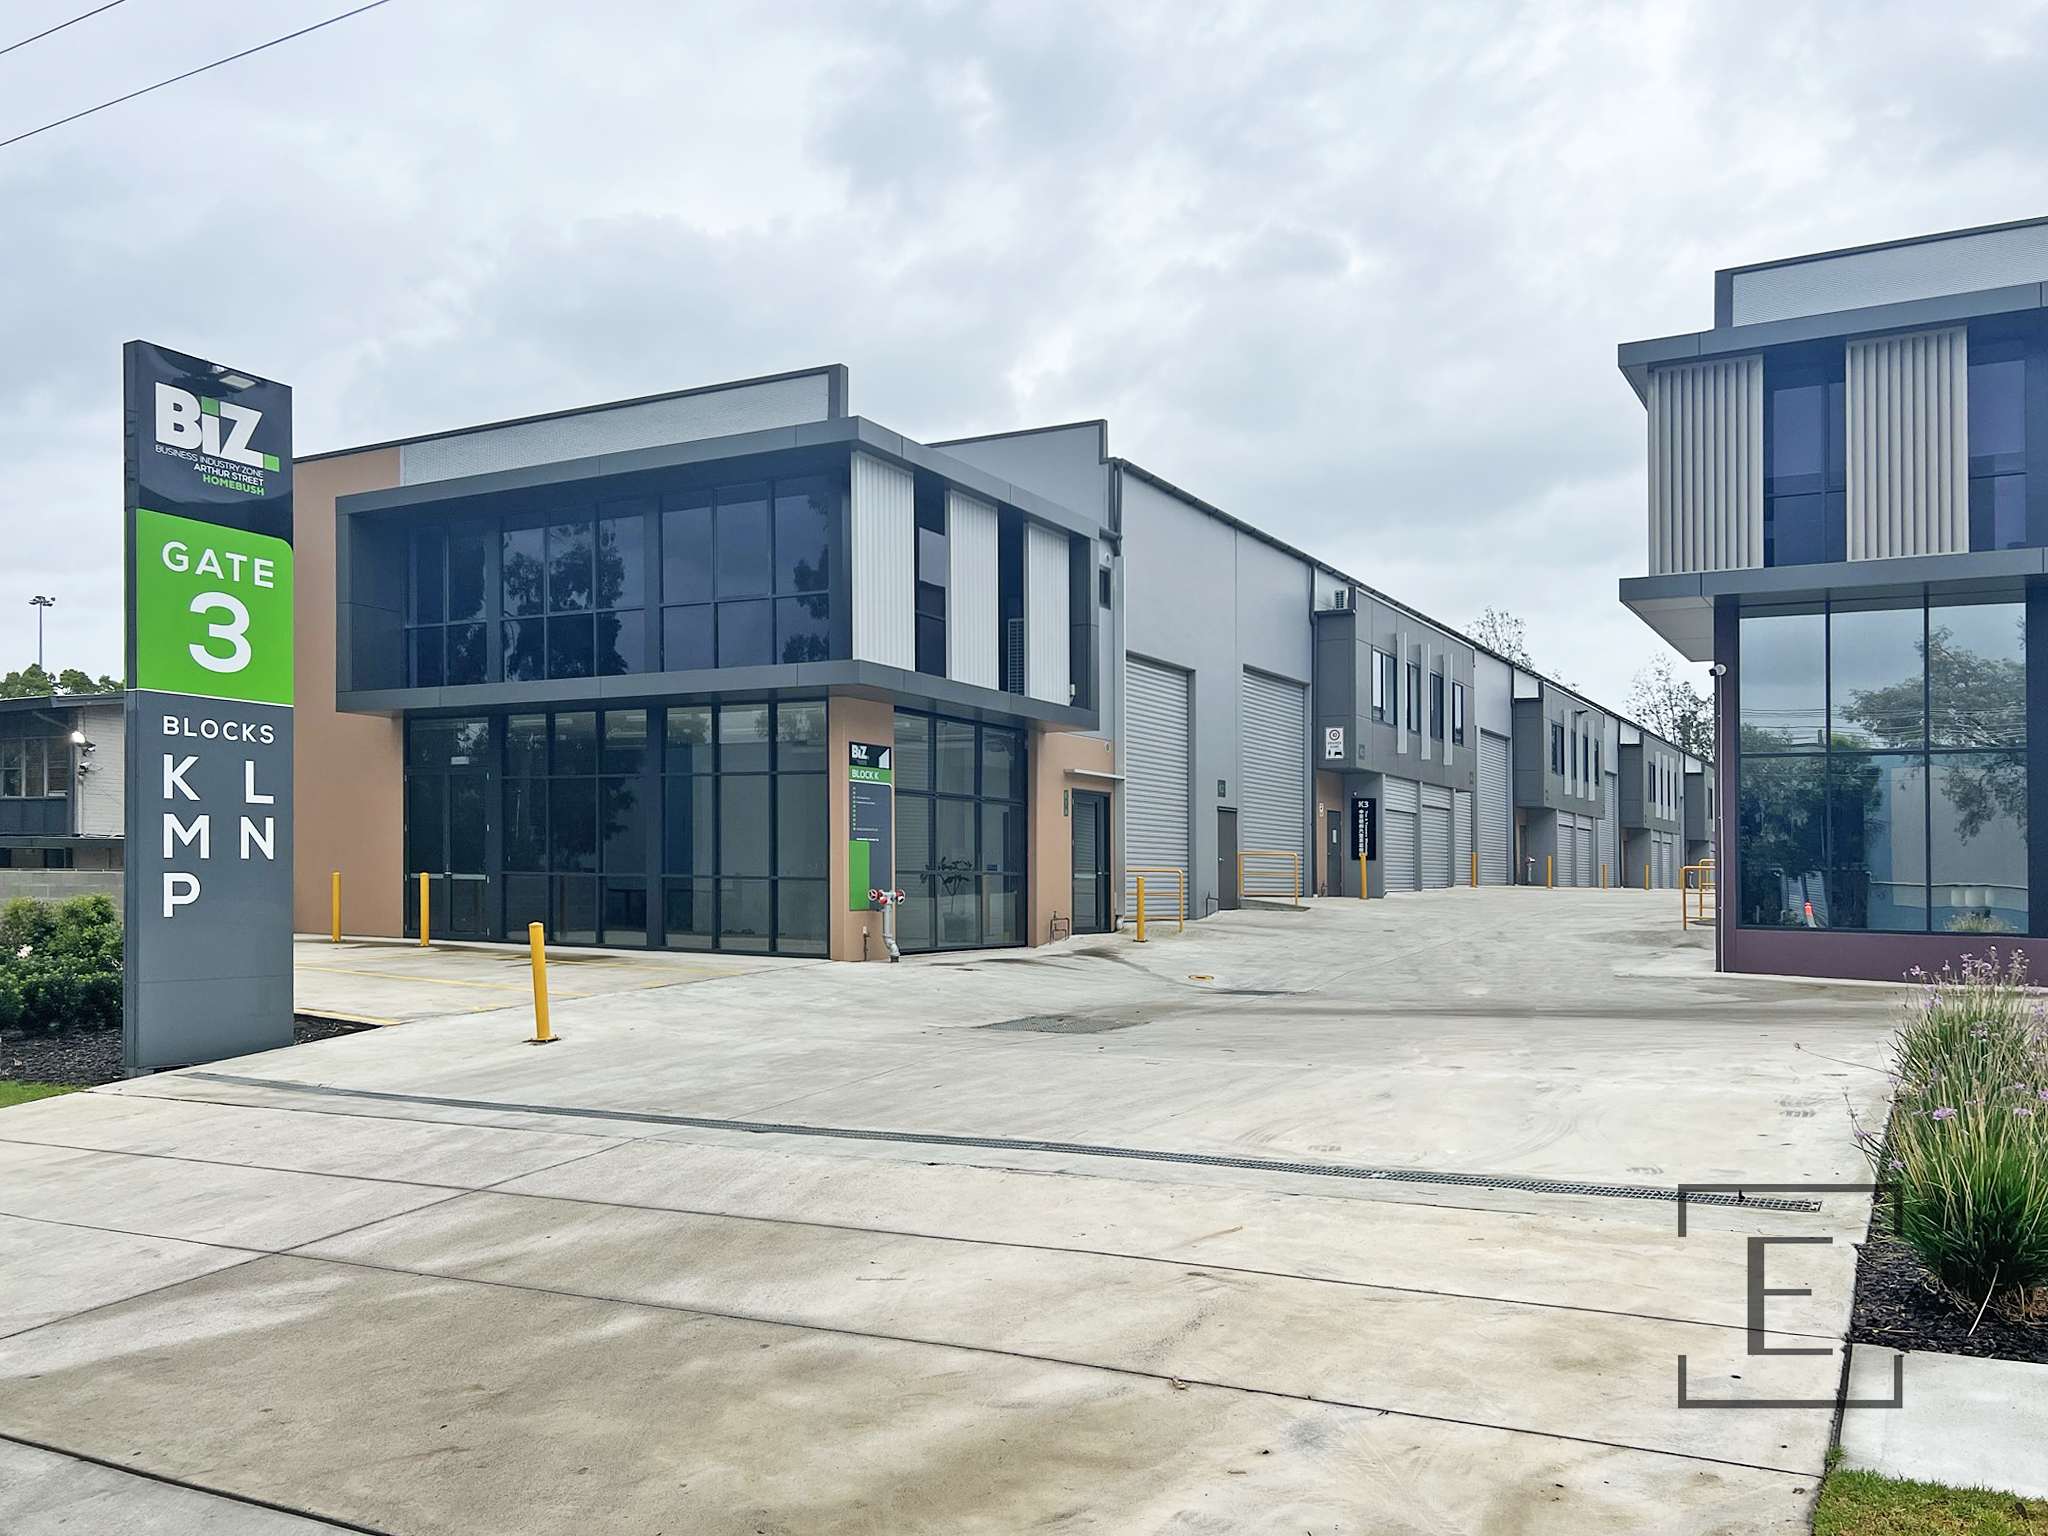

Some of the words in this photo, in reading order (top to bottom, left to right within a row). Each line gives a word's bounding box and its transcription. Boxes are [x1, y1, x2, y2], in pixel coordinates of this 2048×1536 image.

[155, 444, 198, 462] BUSINESS
[200, 456, 240, 472] INDUSTRY
[241, 466, 264, 478] ZONE
[194, 463, 231, 478] ARTHUR
[231, 472, 264, 486] STREET
[203, 474, 265, 496] HOMEBUSH
[162, 541, 274, 588] GATE
[189, 591, 252, 673] 3
[163, 715, 275, 744] BLOCKS
[163, 754, 201, 801] K
[245, 760, 275, 804] L
[852, 769, 873, 779] BLOCK
[874, 771, 879, 780] K
[1358, 800, 1369, 808] K3
[163, 813, 210, 859] M
[240, 816, 275, 860] N
[163, 872, 201, 918] P
